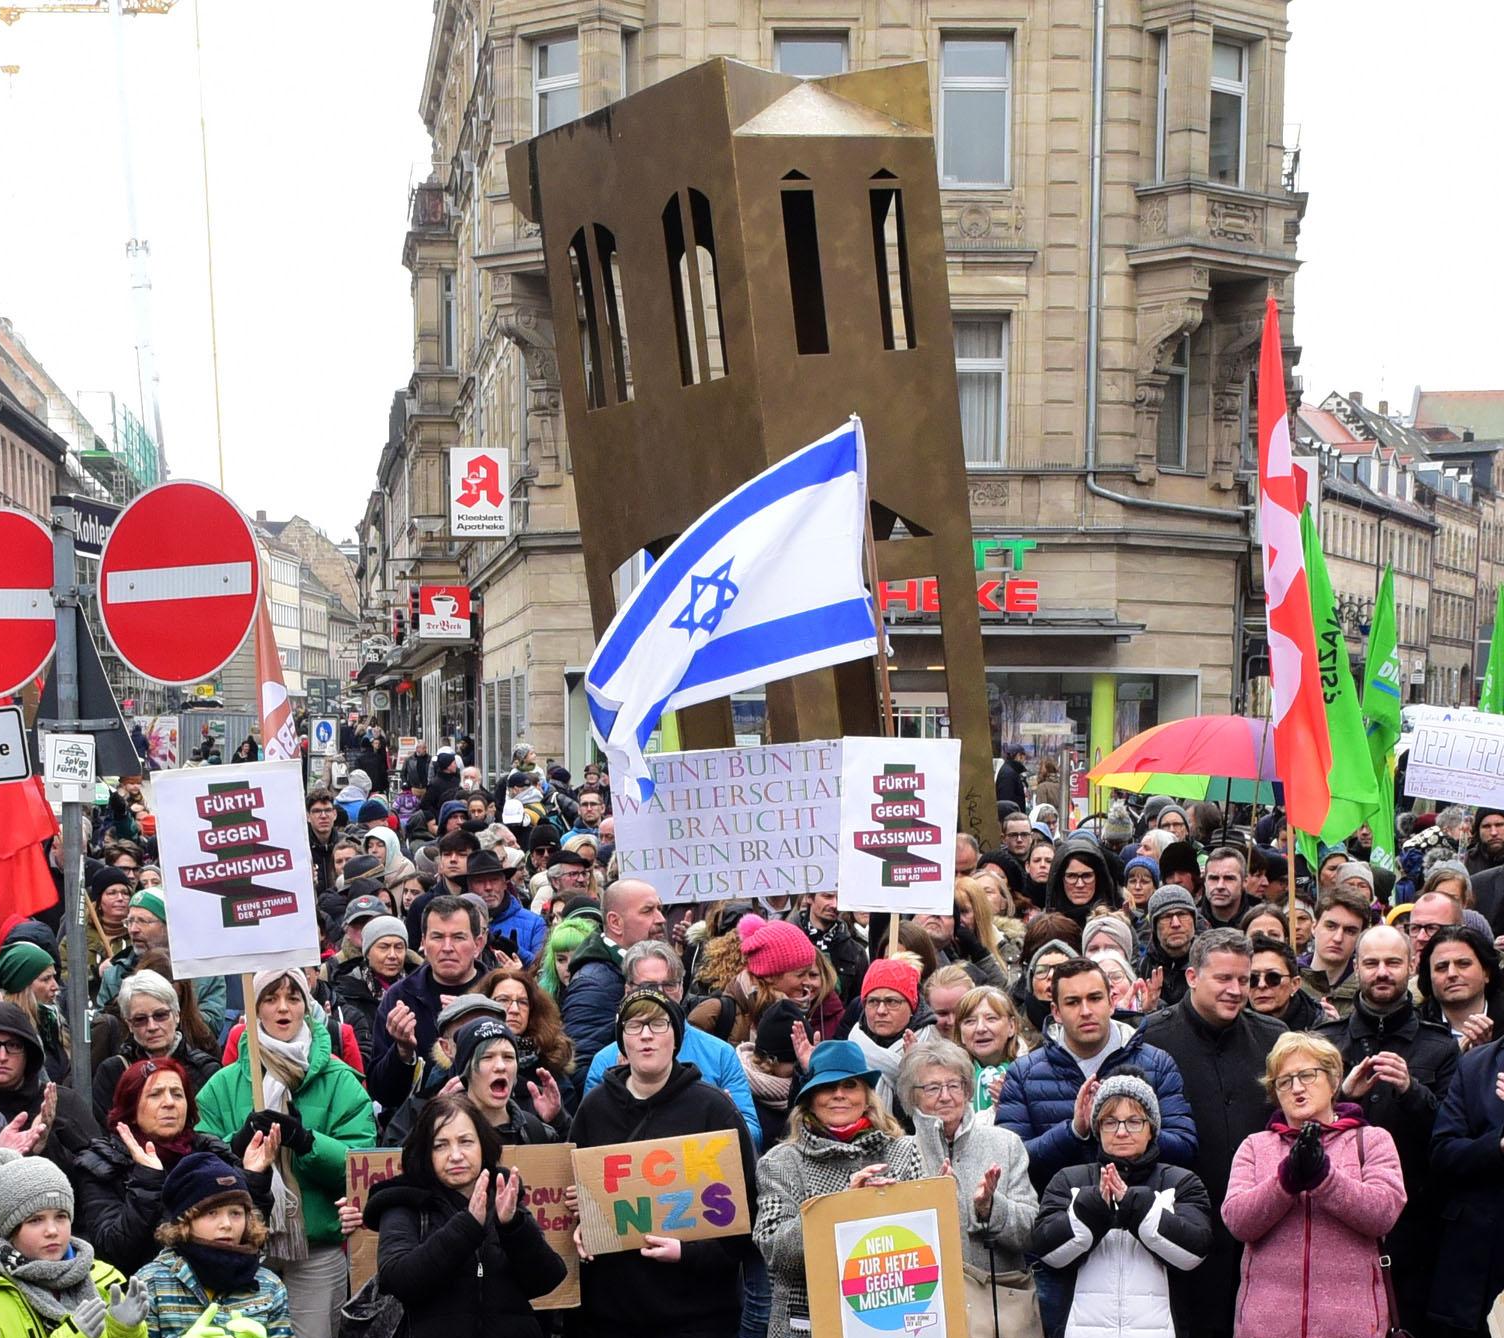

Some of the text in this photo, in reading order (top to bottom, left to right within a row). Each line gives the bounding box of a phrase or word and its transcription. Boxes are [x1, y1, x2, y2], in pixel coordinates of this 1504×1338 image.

[75, 511, 111, 545] Kohler
[456, 522, 505, 531] Apotheke
[56, 764, 78, 774] Fürth
[729, 748, 833, 779] BUNTE
[879, 775, 918, 790] FÜRTH
[204, 793, 256, 814] FÜRTH
[875, 804, 920, 817] GEGEN
[668, 806, 821, 840] BRAUCHT
[205, 825, 261, 846] GEGEN
[862, 831, 933, 845] RASSISMUS
[186, 854, 287, 882] FASCHISMUS
[617, 843, 730, 873] KEINEN
[674, 865, 824, 897] ZUSTAND
[236, 896, 293, 912] KEINE STIMME
[238, 911, 254, 920] DER
[603, 1135, 731, 1193] FCK
[613, 1182, 736, 1236] NZS
[865, 1234, 894, 1255] NEIN
[858, 1252, 920, 1276] ZUR HETZE
[865, 1271, 904, 1293] GEGEN
[859, 1285, 916, 1311] MUSLIME
